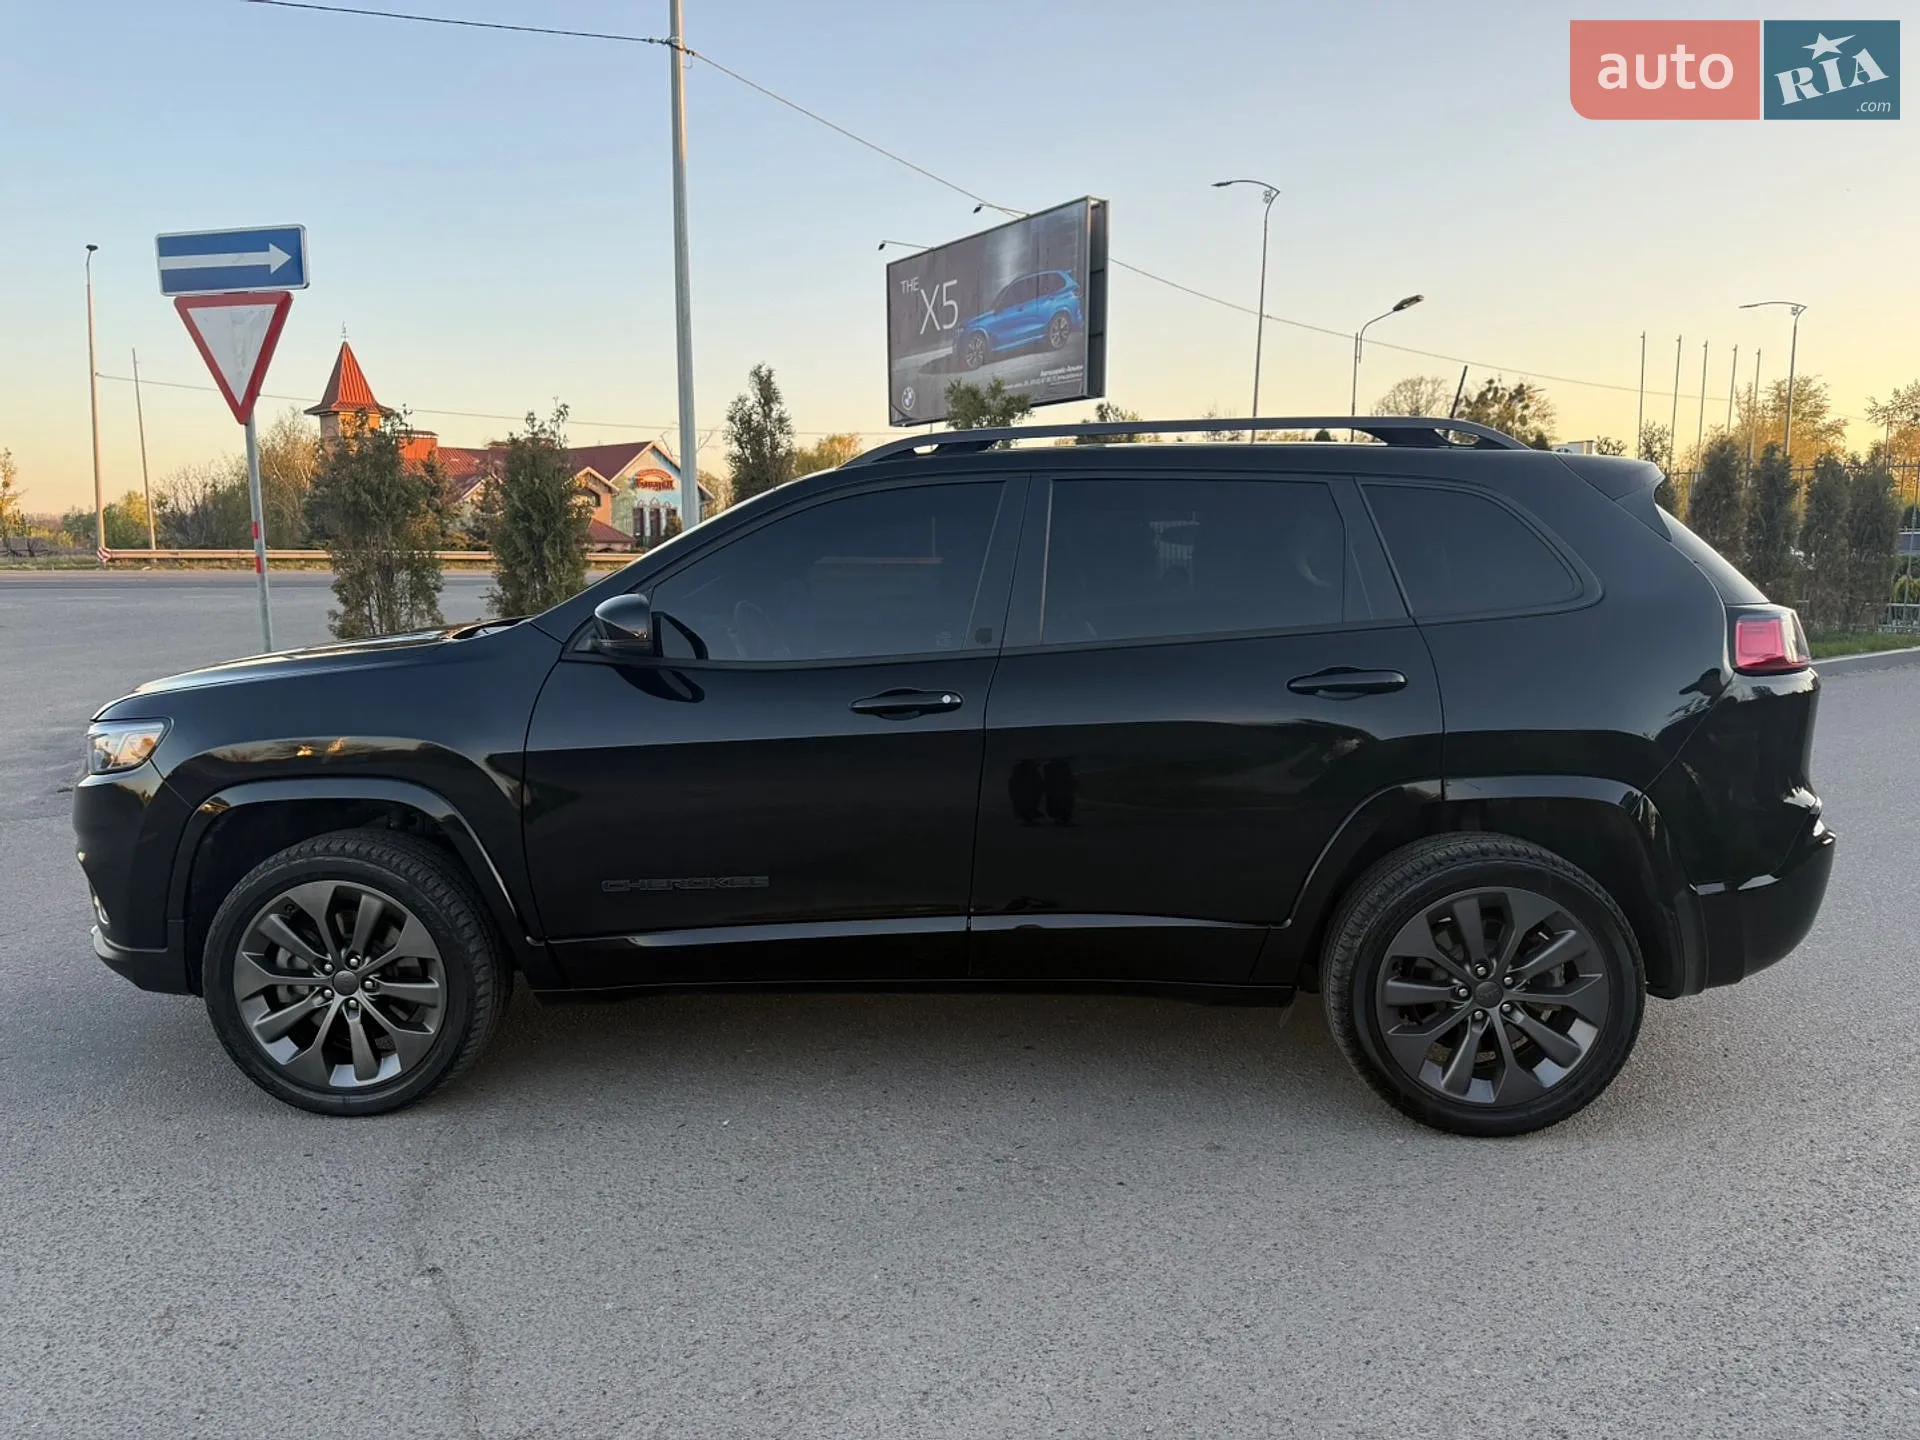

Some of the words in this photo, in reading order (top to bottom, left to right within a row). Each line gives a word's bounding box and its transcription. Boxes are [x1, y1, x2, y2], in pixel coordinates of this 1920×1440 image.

[900, 276, 919, 294] THE
[920, 279, 958, 335] X5
[601, 876, 769, 892] CHEROKEE
